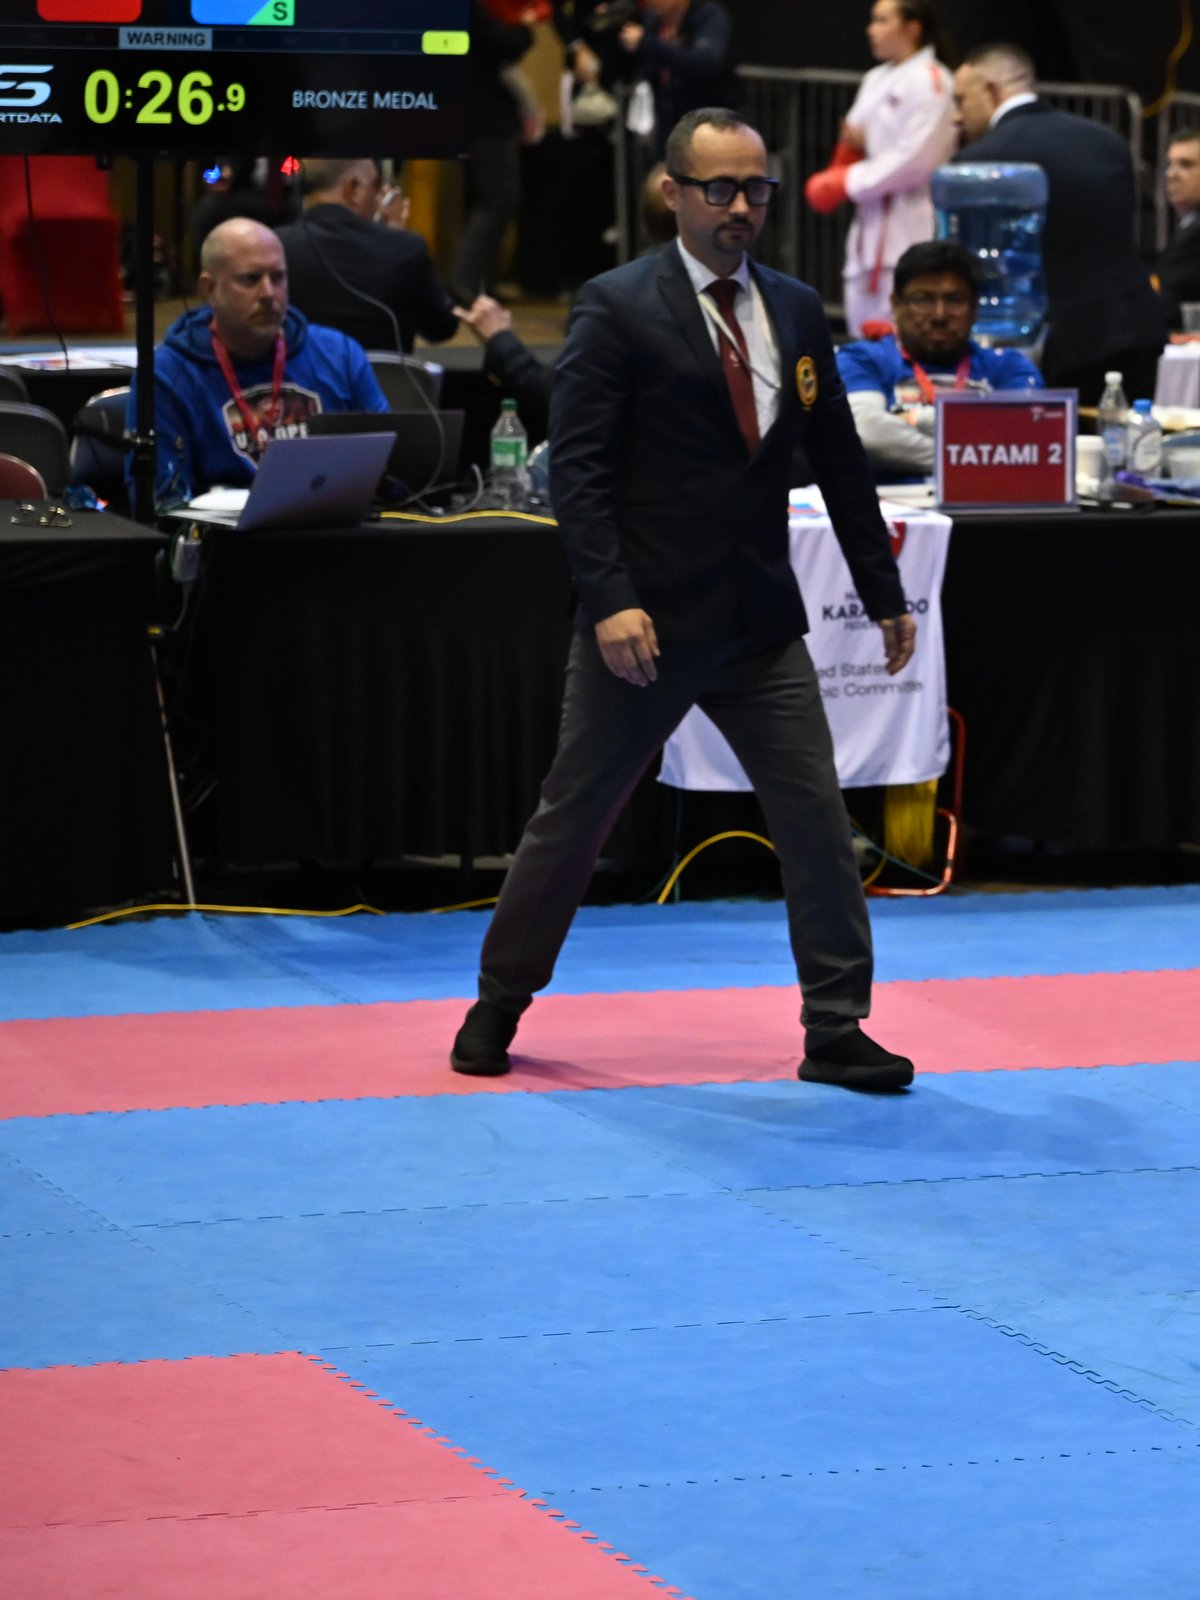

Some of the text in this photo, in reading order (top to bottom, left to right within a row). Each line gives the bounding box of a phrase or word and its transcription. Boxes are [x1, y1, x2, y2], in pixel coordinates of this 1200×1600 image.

[273, 2, 288, 21] S
[127, 31, 206, 46] WARNING
[85, 69, 245, 125] 0:26.9
[292, 90, 438, 109] BRONZE MEDAL
[0, 112, 63, 123] RTDATA
[946, 443, 1062, 465] TATAMI 2
[840, 663, 887, 677] State
